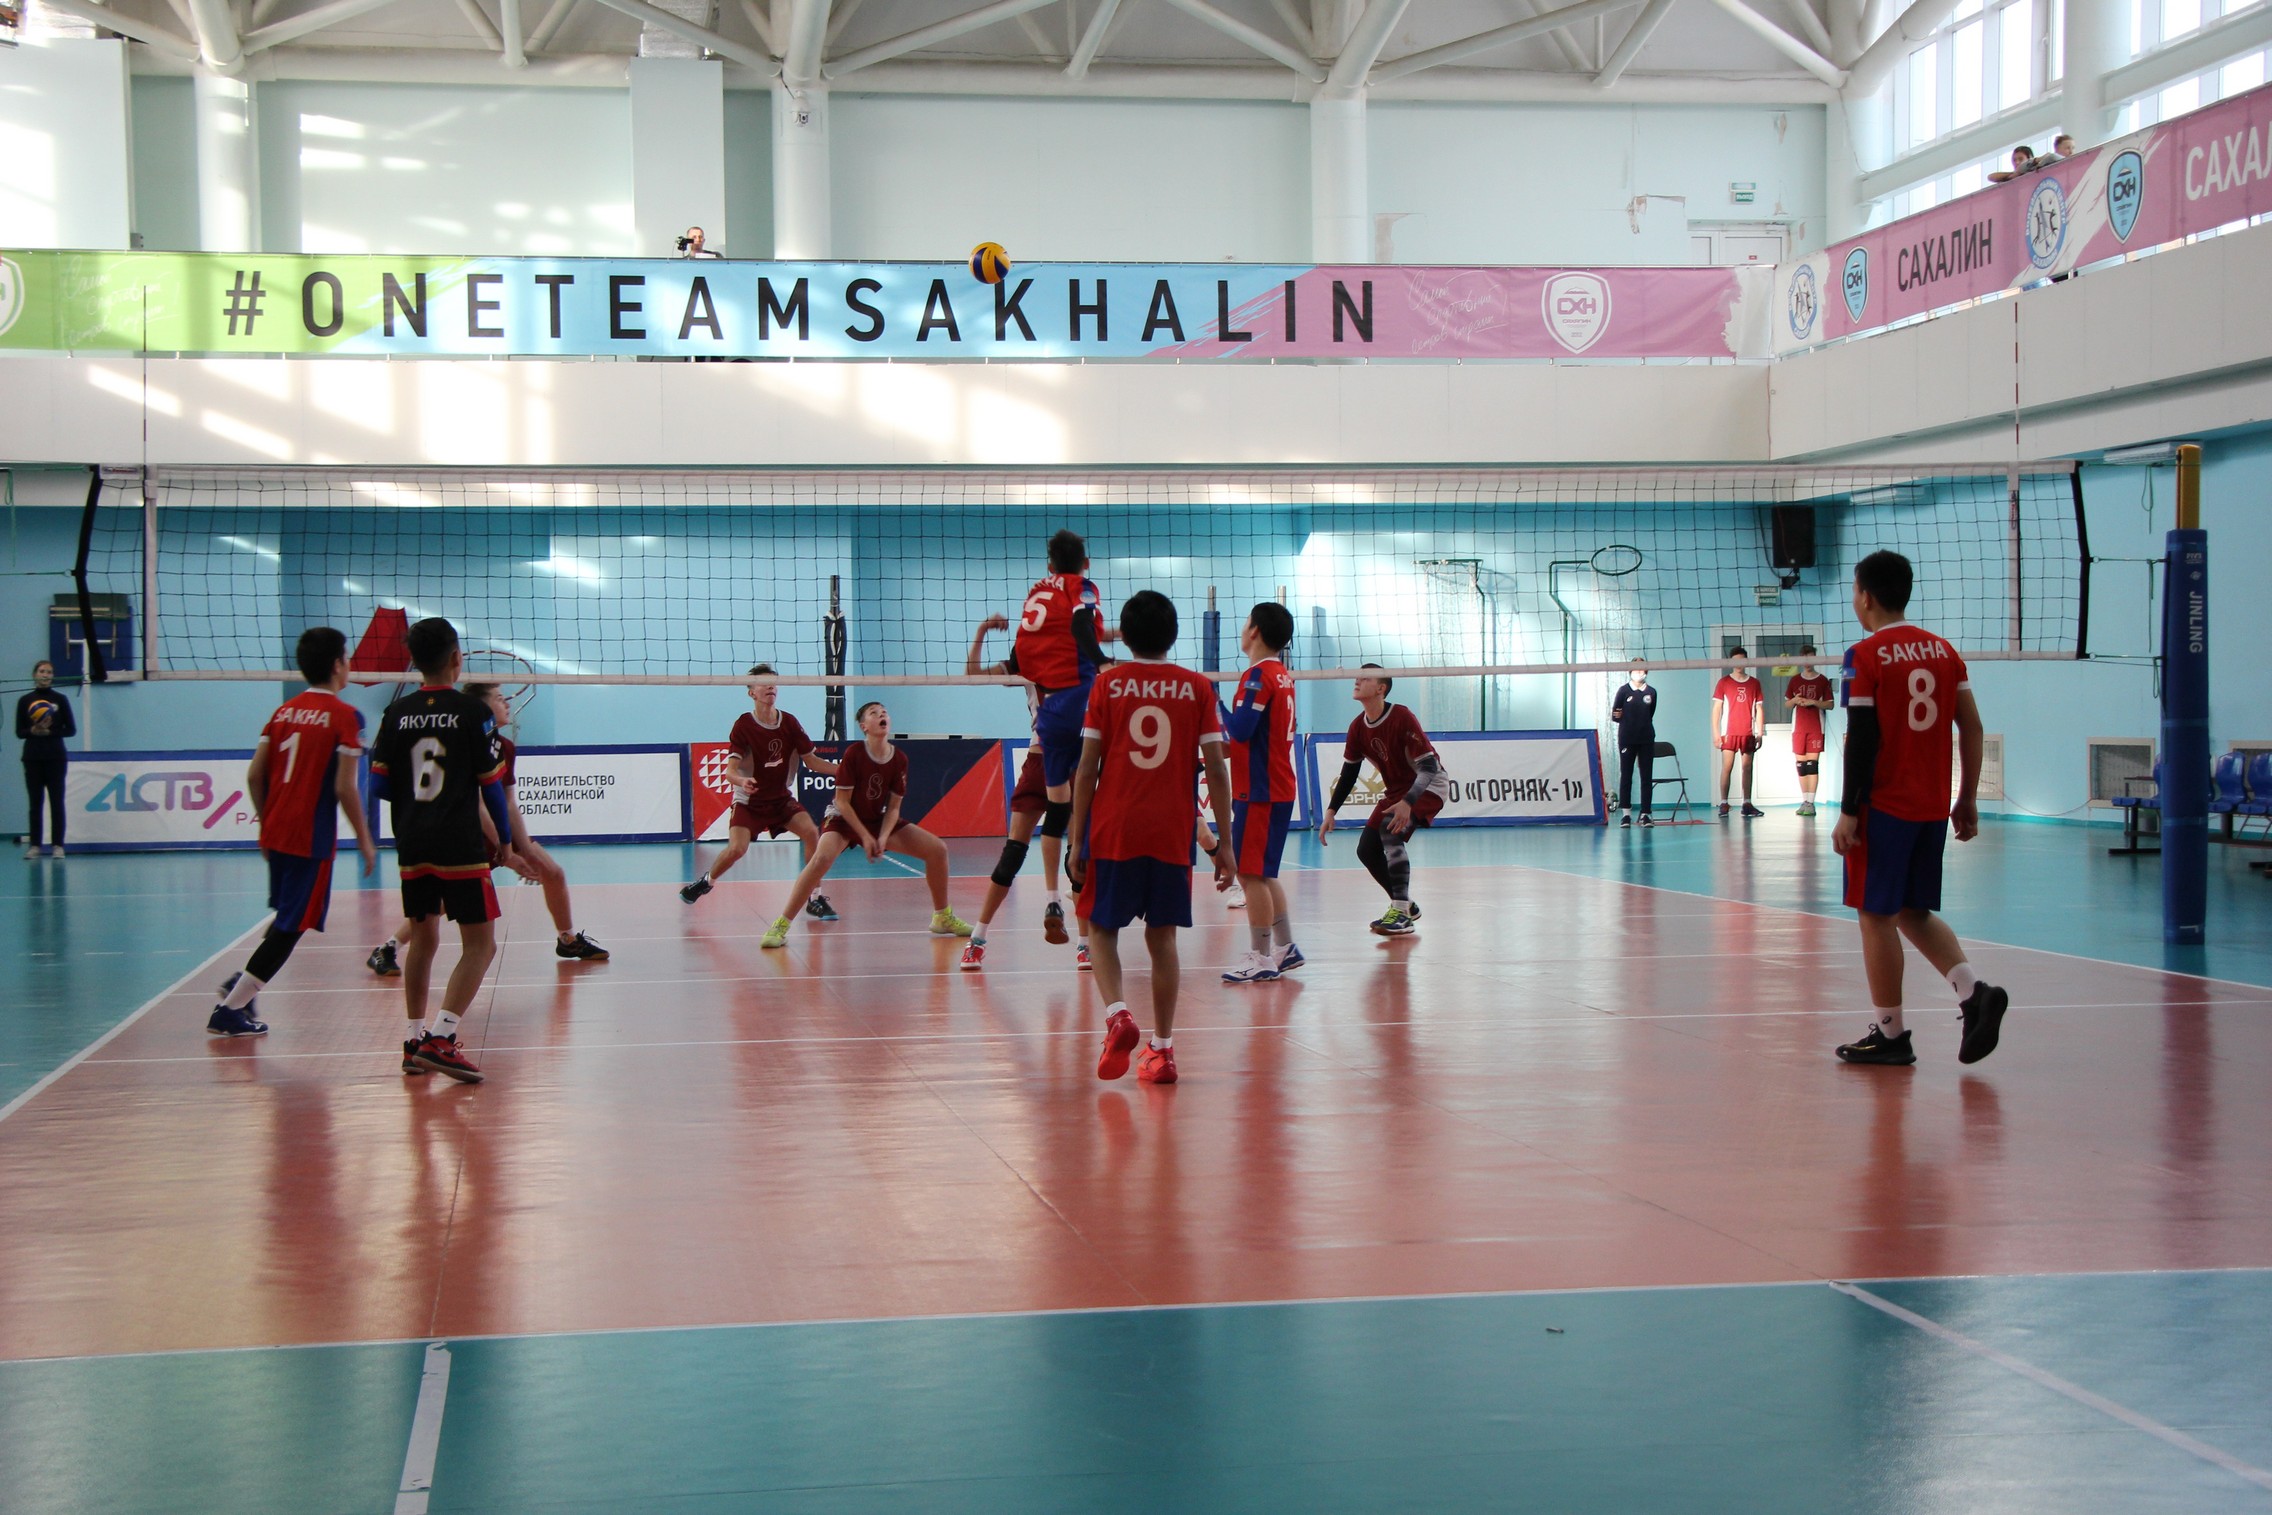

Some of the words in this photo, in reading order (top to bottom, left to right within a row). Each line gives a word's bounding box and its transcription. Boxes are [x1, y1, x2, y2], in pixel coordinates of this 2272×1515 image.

[1897, 218, 1992, 292] САХАЛИН
[223, 270, 1373, 343] #ONETEAMSAKHALIN
[1021, 591, 1054, 632] 5
[2189, 591, 2203, 653] JINLING
[1877, 640, 1949, 666] SAKHA
[1109, 678, 1196, 701] SAKHA
[1736, 687, 1747, 702] 3
[1799, 685, 1817, 700] 15
[1907, 668, 1938, 732] 8
[273, 706, 331, 728] SAKHA
[399, 713, 459, 730] ЯКУТСК
[1286, 695, 1294, 741] 2
[768, 738, 783, 761] 2
[1128, 705, 1172, 770] 9
[279, 732, 300, 783] 1
[411, 737, 446, 801] 6
[518, 775, 615, 787] ПРАВИТЕЛЬСТВО
[866, 773, 884, 800] 8
[1466, 778, 1583, 802] «ГОРНЯК-1»
[518, 788, 605, 801] САХАЛИНСКОЙ
[519, 804, 572, 815] ОБЛАСТИ
